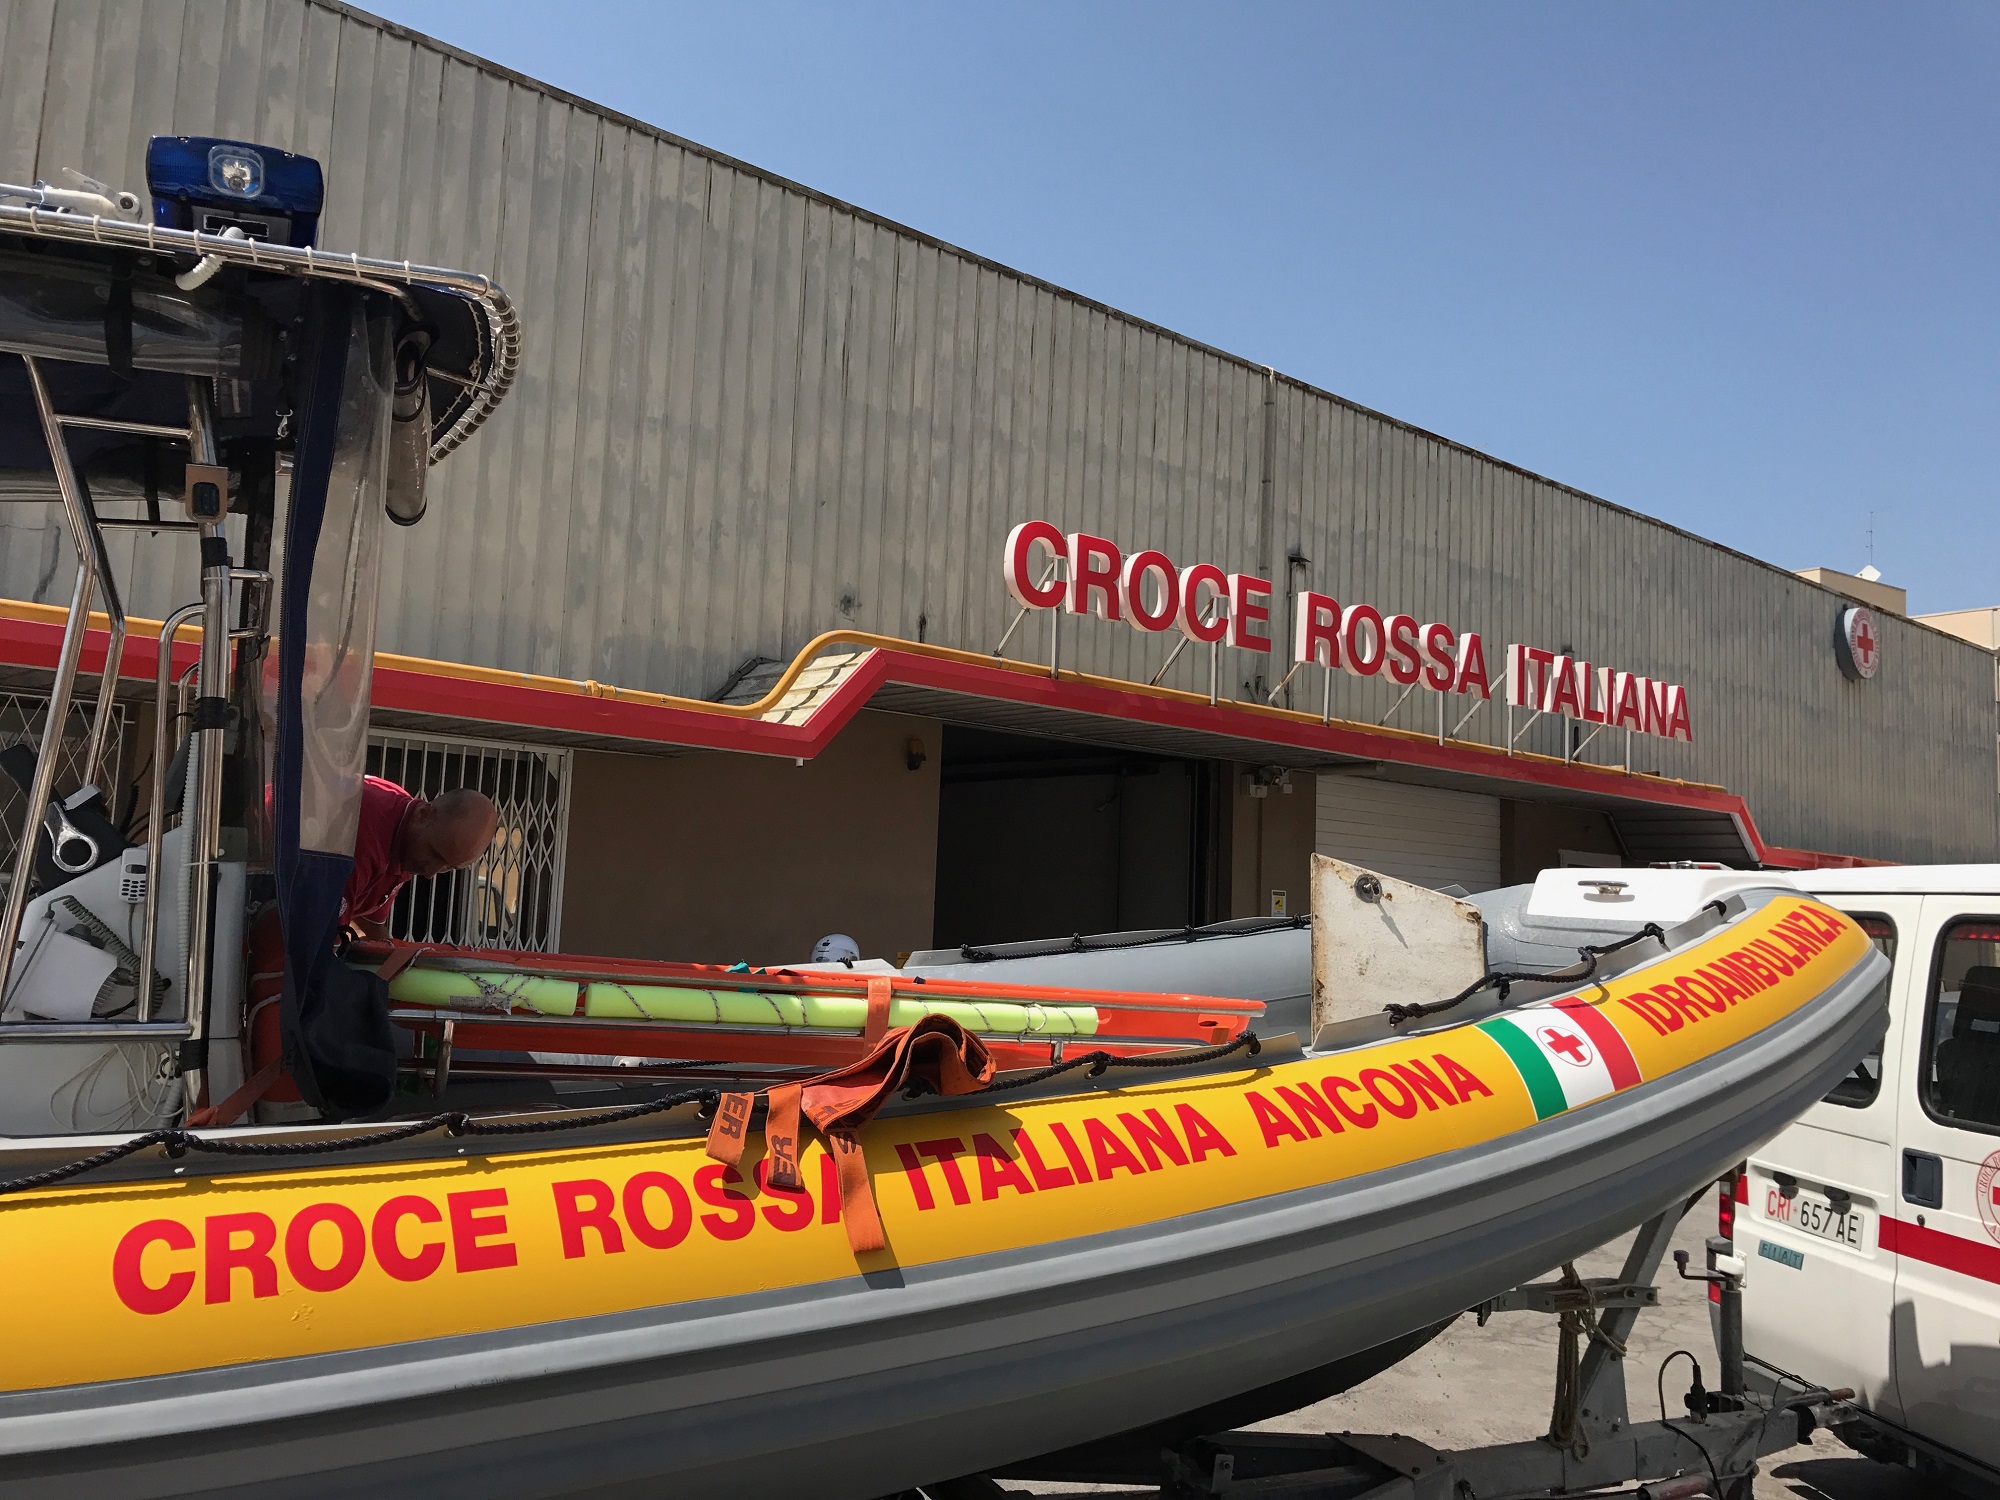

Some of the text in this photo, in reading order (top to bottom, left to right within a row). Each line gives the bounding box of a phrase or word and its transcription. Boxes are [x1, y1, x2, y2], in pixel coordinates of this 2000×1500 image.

[1004, 520, 1693, 742] CROCE ROSSA ITALIANA
[113, 1187, 518, 1315] CROCE
[893, 1103, 1237, 1212] ITALIANA
[1244, 1053, 1494, 1149] ANCONA
[1616, 904, 1848, 1037] IDROAMBULANZA
[719, 1092, 749, 1140] ER
[1767, 1190, 1792, 1221] CRI
[1761, 1243, 1801, 1267] FIAT
